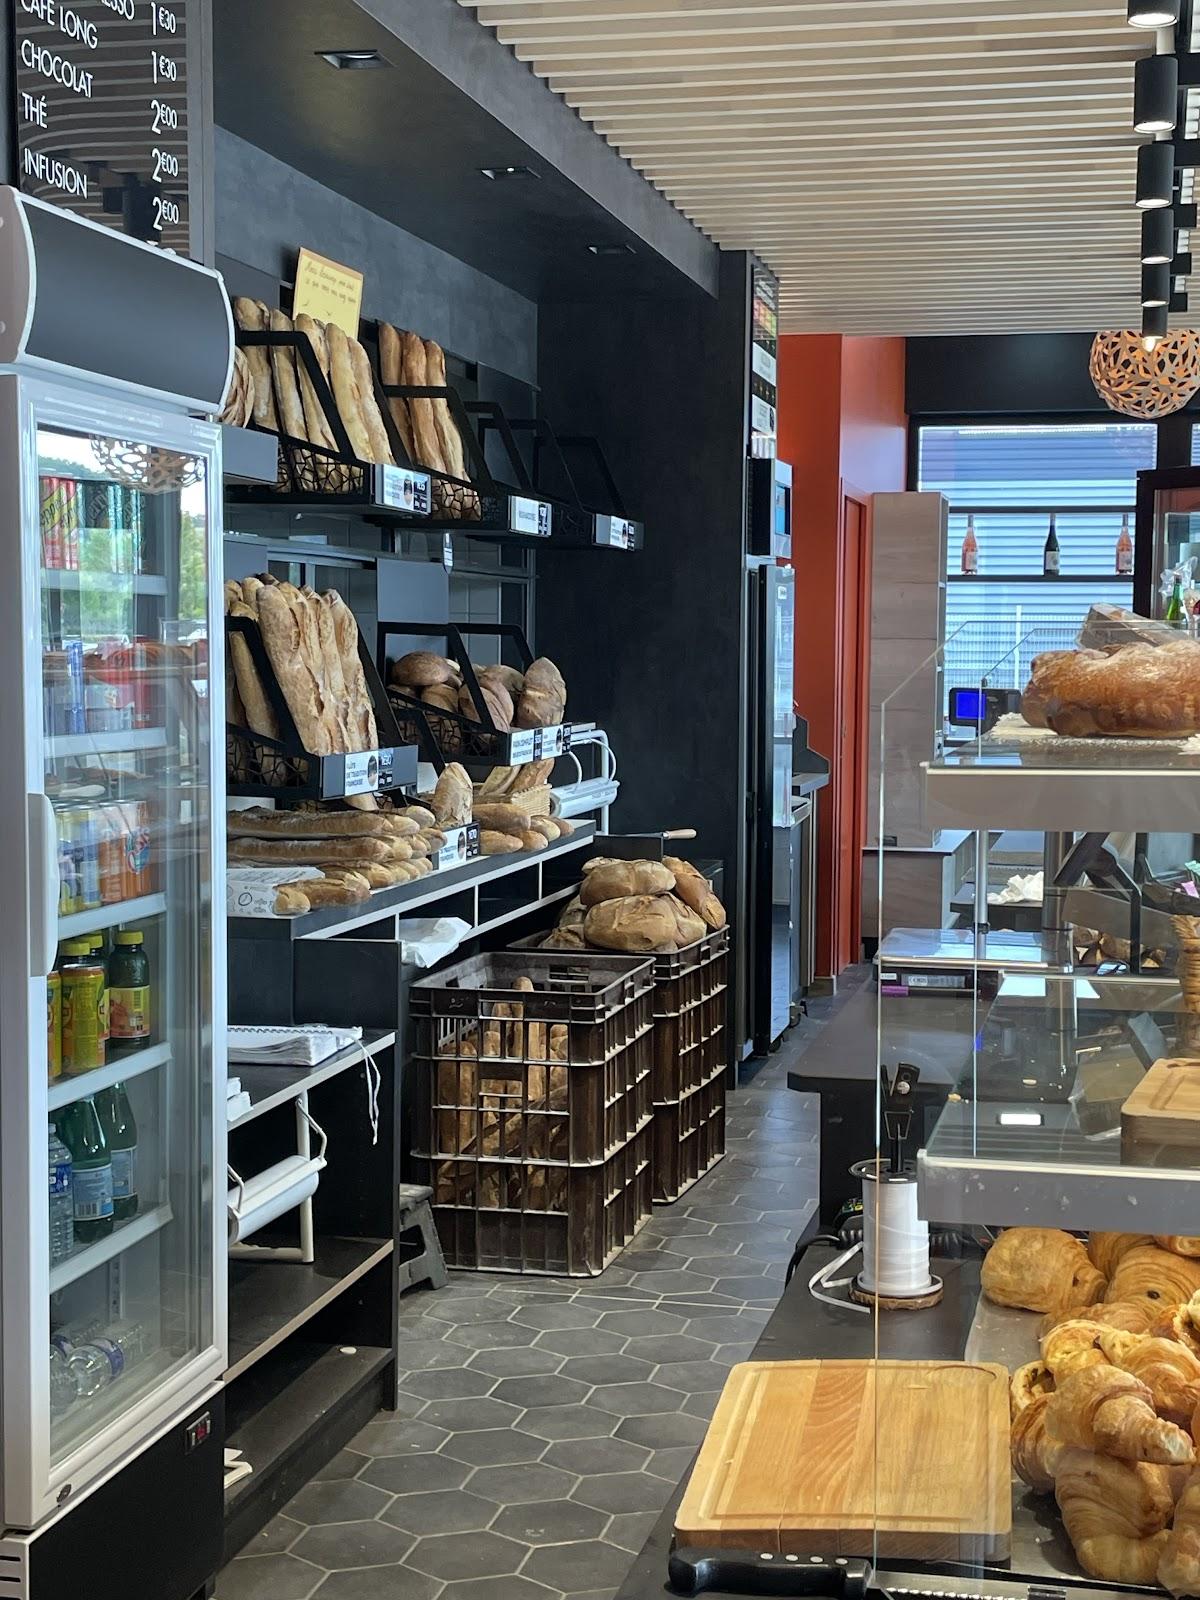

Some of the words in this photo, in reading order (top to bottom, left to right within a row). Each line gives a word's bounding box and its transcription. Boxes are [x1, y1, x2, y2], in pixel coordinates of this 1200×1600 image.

[59, 5, 98, 49] LONG
[151, 50, 177, 84] 1€30
[151, 2, 176, 35] 1€30
[21, 39, 93, 98] CHOCOLAT
[151, 99, 178, 134] 2€00
[22, 92, 48, 128] THÉ
[152, 148, 178, 183] 2€00
[24, 148, 88, 198] INFUSION
[152, 196, 179, 230] 2€00
